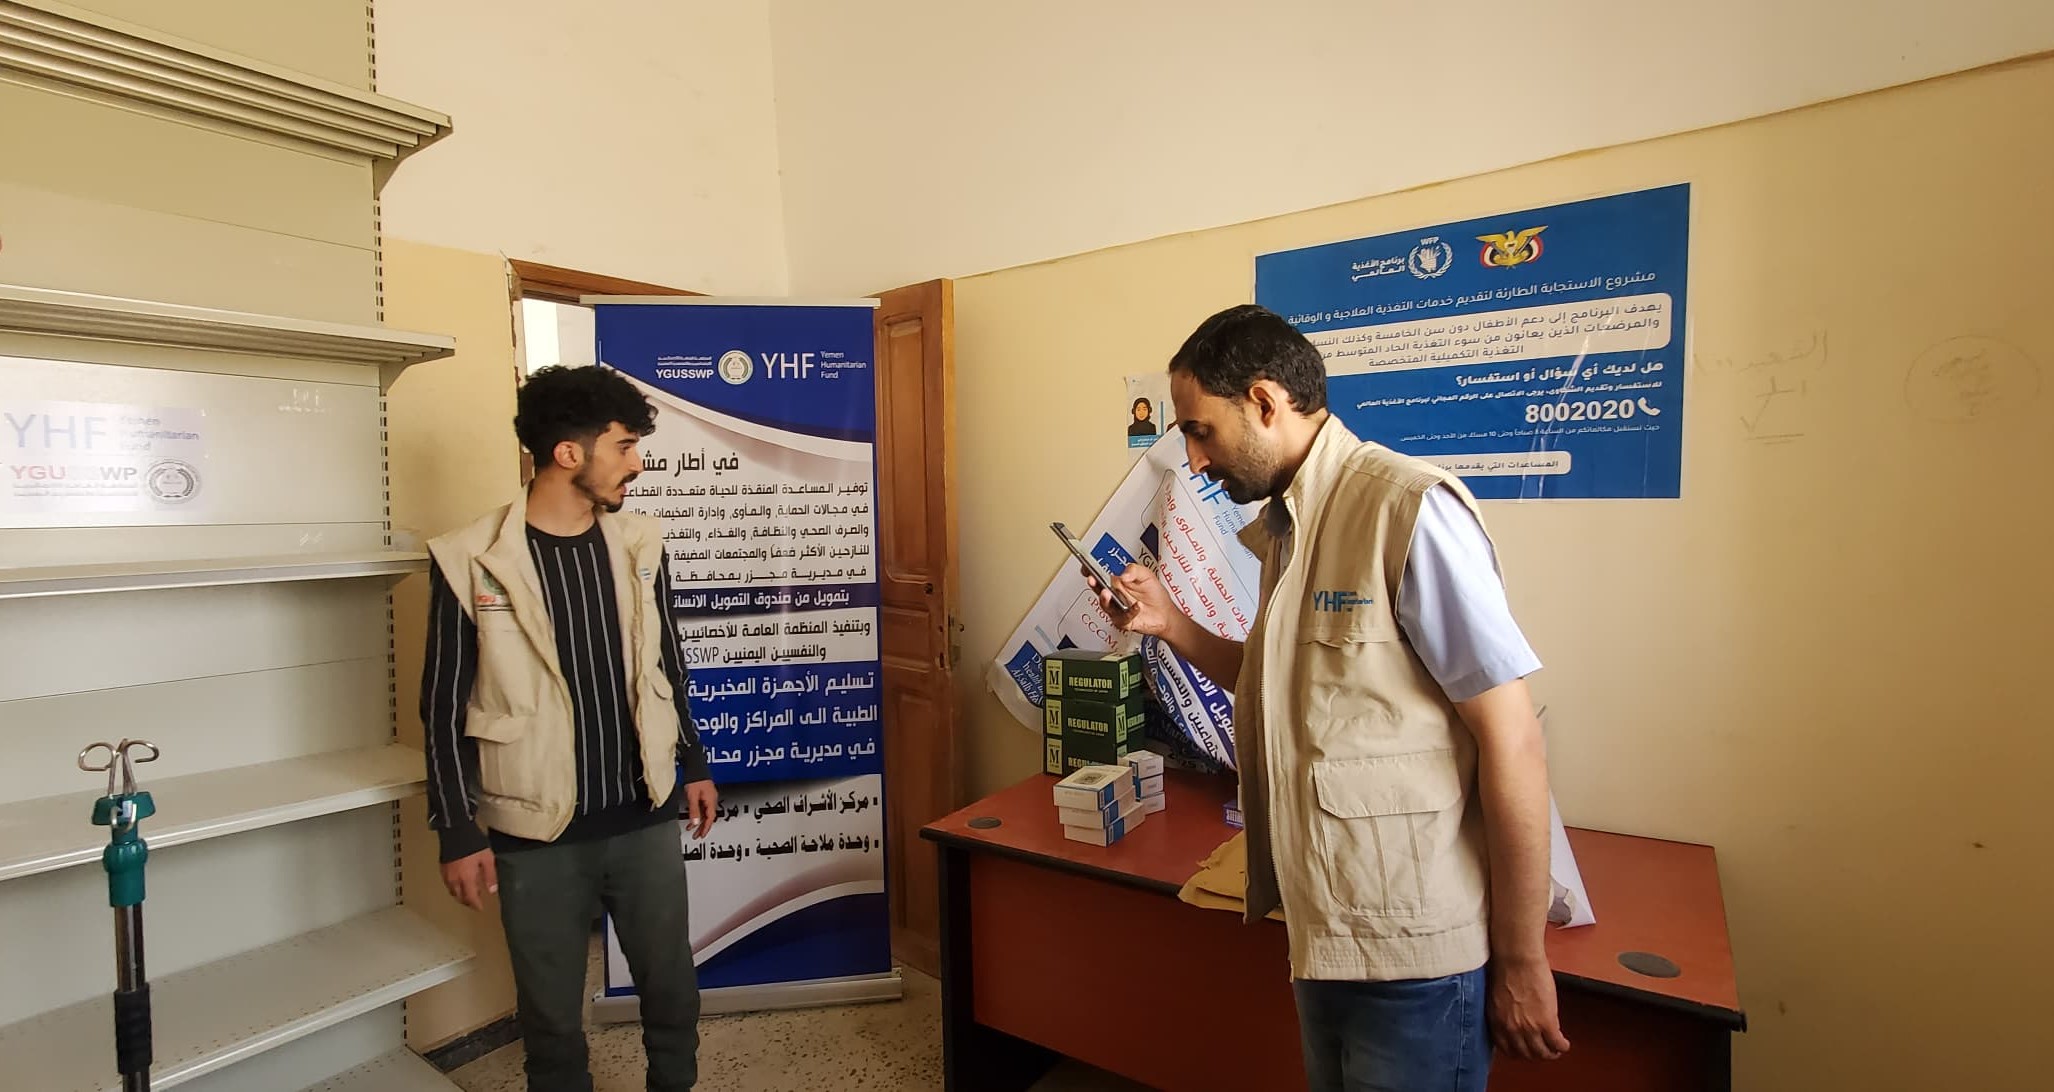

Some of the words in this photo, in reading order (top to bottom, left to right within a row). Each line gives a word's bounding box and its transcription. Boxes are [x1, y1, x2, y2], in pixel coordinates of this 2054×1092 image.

[1541, 276, 1601, 294] الاستجابة
[1605, 272, 1656, 290] مشروع
[1455, 290, 1492, 308] لتقديم
[1496, 284, 1537, 300] الطارئة
[1375, 300, 1413, 315] التغذية
[1416, 293, 1453, 309] خدمات
[1623, 302, 1662, 315] يهدف
[1325, 312, 1331, 321] و
[1333, 304, 1373, 320] العلاجية
[1550, 311, 1566, 324] إلى
[1570, 305, 1619, 321] البرنامج
[1449, 322, 1470, 335] دون
[1474, 316, 1518, 332] الأطفال
[1521, 316, 1544, 328] دعم
[1583, 317, 1660, 333] والمرضعات
[1341, 332, 1372, 345] وكذلك
[1375, 327, 1420, 341] الخامسة
[1424, 326, 1445, 338] سن
[1484, 333, 1500, 345] من
[1505, 329, 1544, 345] يعانون
[1548, 324, 1579, 338] الذين
[1312, 336, 1339, 348] النسا
[1385, 343, 1409, 354] الحاد
[1412, 340, 1450, 353] التغذية
[1454, 336, 1480, 348] سوء
[820, 351, 845, 359] Yemen
[1336, 346, 1382, 359] المتوسط
[1430, 349, 1479, 363] التكميلية
[1482, 345, 1524, 359] التغذية
[761, 352, 815, 380] YHF
[820, 361, 867, 369] Humanitarian
[1369, 355, 1427, 367] المتخصصة
[1640, 361, 1664, 374] هل
[656, 369, 714, 380] YGUSSWP
[820, 371, 839, 379] Fund
[1523, 367, 1536, 382] أو
[1539, 367, 1577, 381] سؤال
[1582, 363, 1598, 380] أي
[1602, 362, 1636, 377] لديك
[1456, 371, 1520, 388] استفسار؟
[1525, 399, 1635, 424] 8002020
[3, 412, 107, 449] YHF
[642, 450, 668, 472] مش
[674, 448, 705, 478] أطار
[713, 450, 739, 476] في
[1487, 462, 1504, 471] التي
[1508, 461, 1559, 469] المساعدات
[10, 465, 138, 481] YGUWP
[665, 485, 706, 498] متعددة
[709, 484, 738, 498] للحياة
[742, 484, 778, 497] المنقذة
[782, 482, 833, 495] المساعدة
[837, 480, 869, 497] توفير
[1181, 462, 1231, 505] HF
[698, 505, 726, 521] وإدارة
[813, 504, 848, 517] مجالات
[850, 505, 869, 518] في
[1231, 504, 1246, 527] Yeme
[800, 525, 831, 541] الصحي
[834, 524, 869, 540] والصرف
[1213, 515, 1229, 536] Fund
[662, 528, 701, 543] والتغذي
[673, 549, 711, 564] المضيفة
[714, 546, 767, 563] والمجتمعات
[798, 543, 826, 561] الأكثر
[829, 544, 870, 560] للنازحين
[675, 569, 741, 584] بمحافظة
[744, 568, 788, 585] مجزر
[791, 566, 843, 581] مديرية
[845, 565, 867, 578] في
[673, 593, 707, 609] الانسان
[710, 592, 750, 611] التمويل
[754, 591, 791, 610] صندوق
[794, 590, 810, 607] من
[813, 589, 850, 607] بتمويل
[1190, 575, 1217, 618] والصحة
[1313, 590, 1348, 613] YHF
[680, 621, 738, 643] للأخصائيين
[742, 622, 779, 637] العامة
[784, 621, 828, 635] المنظمة
[832, 619, 871, 637] وبتنفيذ
[723, 646, 766, 664] اليمنيين
[771, 645, 826, 662] والنفسيين
[762, 670, 819, 700] الأجهزة
[824, 671, 874, 697] تسليم
[1049, 670, 1060, 686] M
[1068, 676, 1113, 689] REGULATOR
[1158, 648, 1192, 709] والنفسيين
[687, 677, 756, 702] المخبرية
[691, 711, 738, 736] والوحد
[743, 709, 793, 734] المراكز
[799, 706, 826, 725] الى
[832, 704, 878, 727] الطبية
[1049, 710, 1060, 726] M
[1067, 717, 1109, 733] REGULATOR
[706, 744, 742, 764] محا
[746, 746, 784, 767] مجزر
[790, 743, 842, 764] مديرية
[847, 738, 876, 762] في
[1049, 749, 1060, 764] M
[753, 791, 790, 823] الصحي
[793, 788, 837, 816] الأشراف
[839, 790, 869, 815] مركز
[755, 835, 797, 860] الصحية
[801, 832, 834, 852] ملاحة
[838, 833, 870, 854] وحدة
[683, 842, 706, 861] الصل
[710, 841, 742, 862] وحدة
